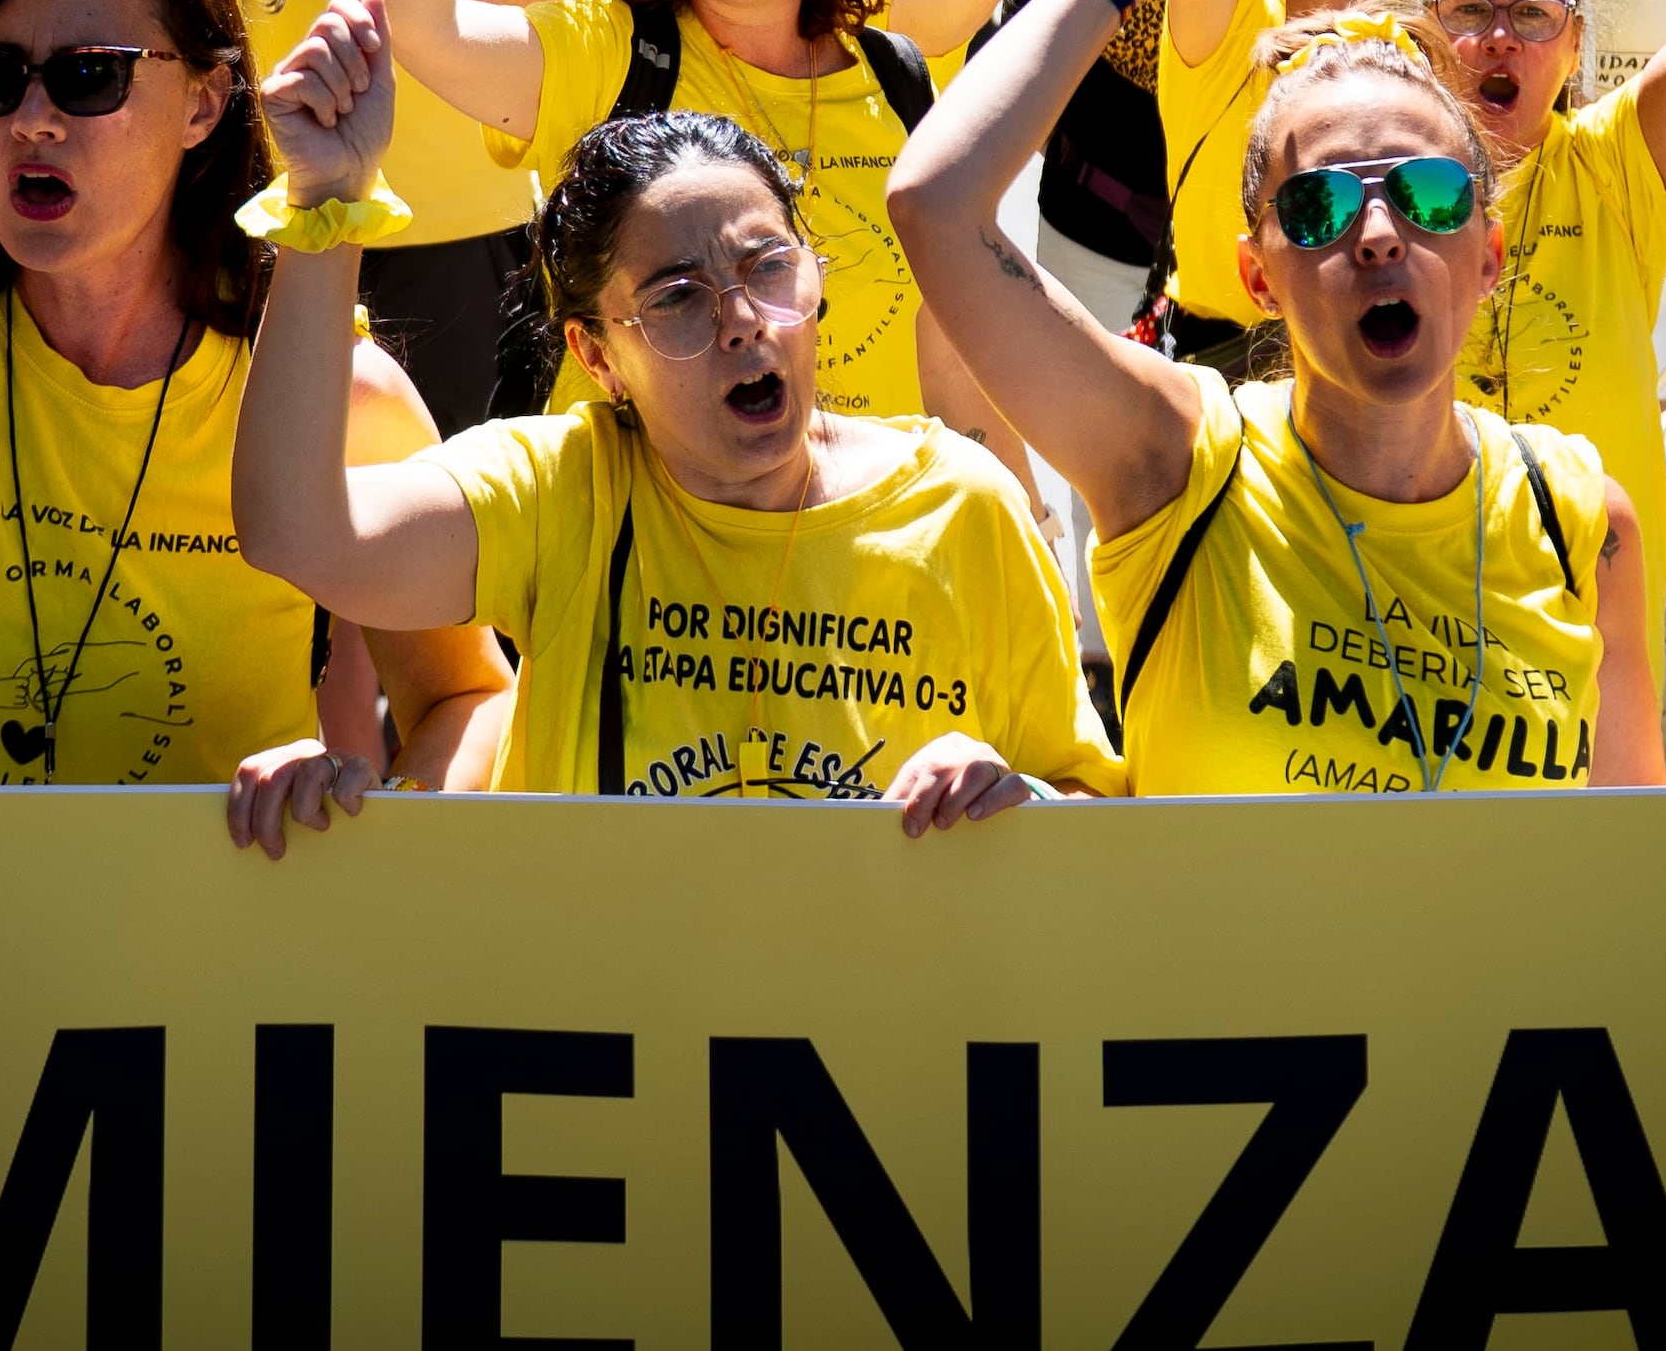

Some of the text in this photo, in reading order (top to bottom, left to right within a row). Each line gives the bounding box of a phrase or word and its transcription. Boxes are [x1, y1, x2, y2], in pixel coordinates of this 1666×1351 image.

[819, 155, 901, 170] LA INFANCI
[1538, 223, 1584, 239] NFANC
[1518, 273, 1580, 333] ABORAL
[30, 502, 74, 530] VOZ
[110, 528, 143, 552] LA
[147, 531, 240, 555] INFANC
[648, 595, 914, 658] POR DIGNIFICAR
[1364, 589, 1414, 631] LA
[108, 580, 188, 717] LABORAL
[1310, 619, 1572, 702] DEBERIA SER
[616, 643, 968, 718] A ETAPA EDUCATIVA 0-3
[1248, 659, 1593, 781] AMARILLA
